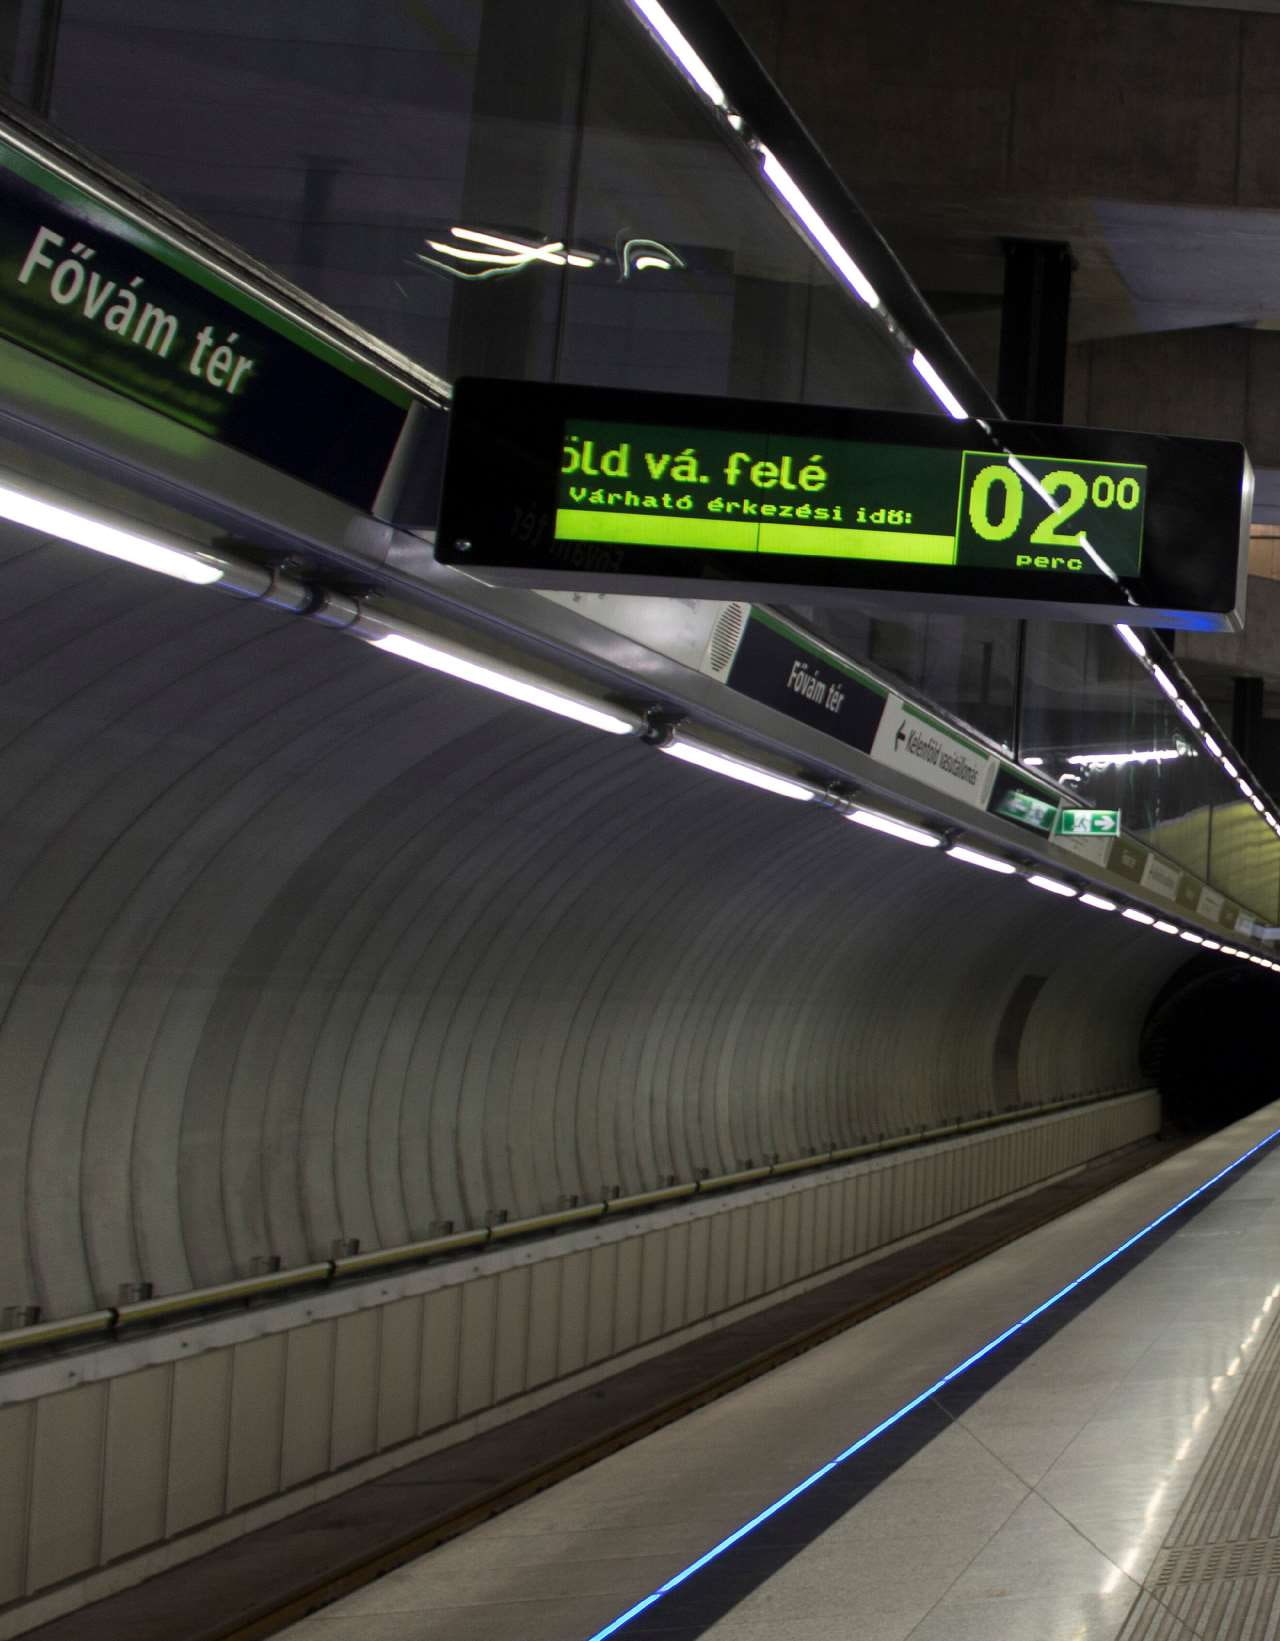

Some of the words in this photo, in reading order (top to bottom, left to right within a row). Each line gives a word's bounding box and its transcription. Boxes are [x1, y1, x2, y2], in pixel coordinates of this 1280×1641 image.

[17, 225, 179, 358] Fővám
[188, 323, 255, 395] tér
[644, 448, 711, 484] vá.
[723, 452, 828, 492] felé
[569, 487, 694, 510] Várható
[707, 497, 843, 521] érkezési
[1016, 554, 1083, 570] perc
[786, 660, 826, 704] Fővám
[825, 682, 845, 713] tér
